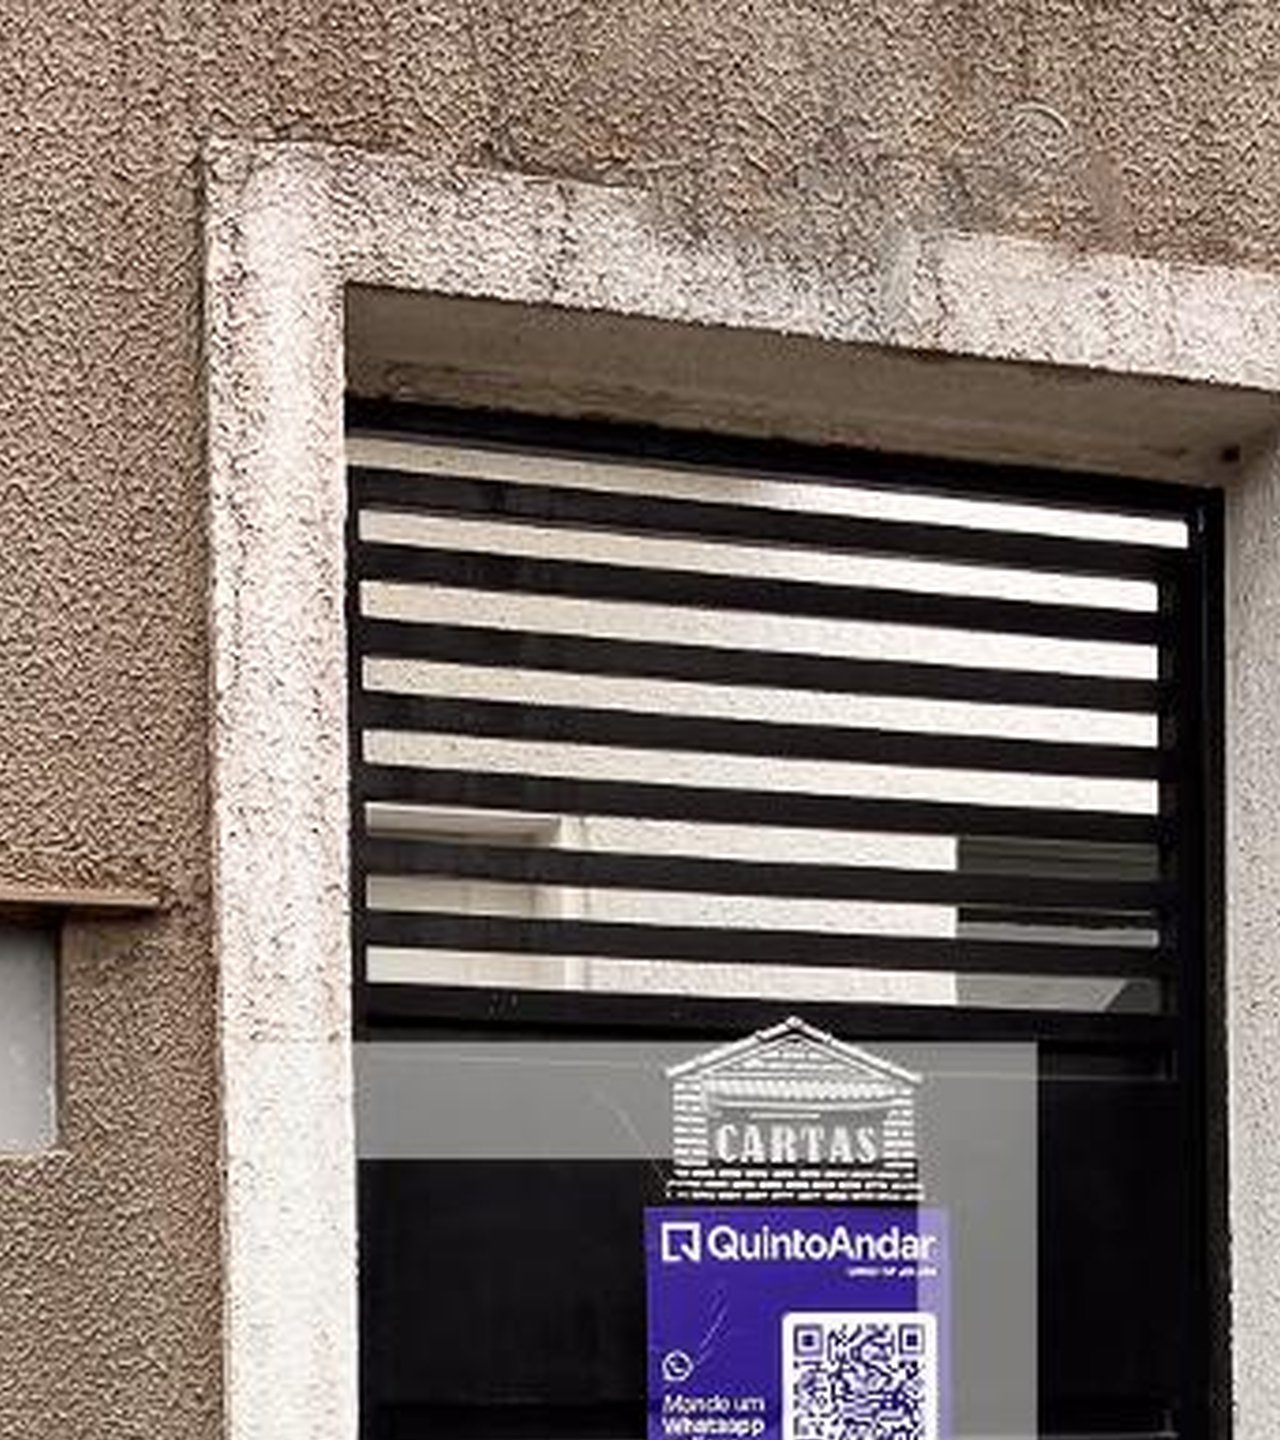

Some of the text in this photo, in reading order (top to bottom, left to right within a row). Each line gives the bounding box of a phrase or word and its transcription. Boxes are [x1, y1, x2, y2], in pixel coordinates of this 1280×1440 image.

[716, 1124, 877, 1164] CARTAS
[707, 1225, 937, 1262] QuintoAndar
[733, 1397, 765, 1412] um
